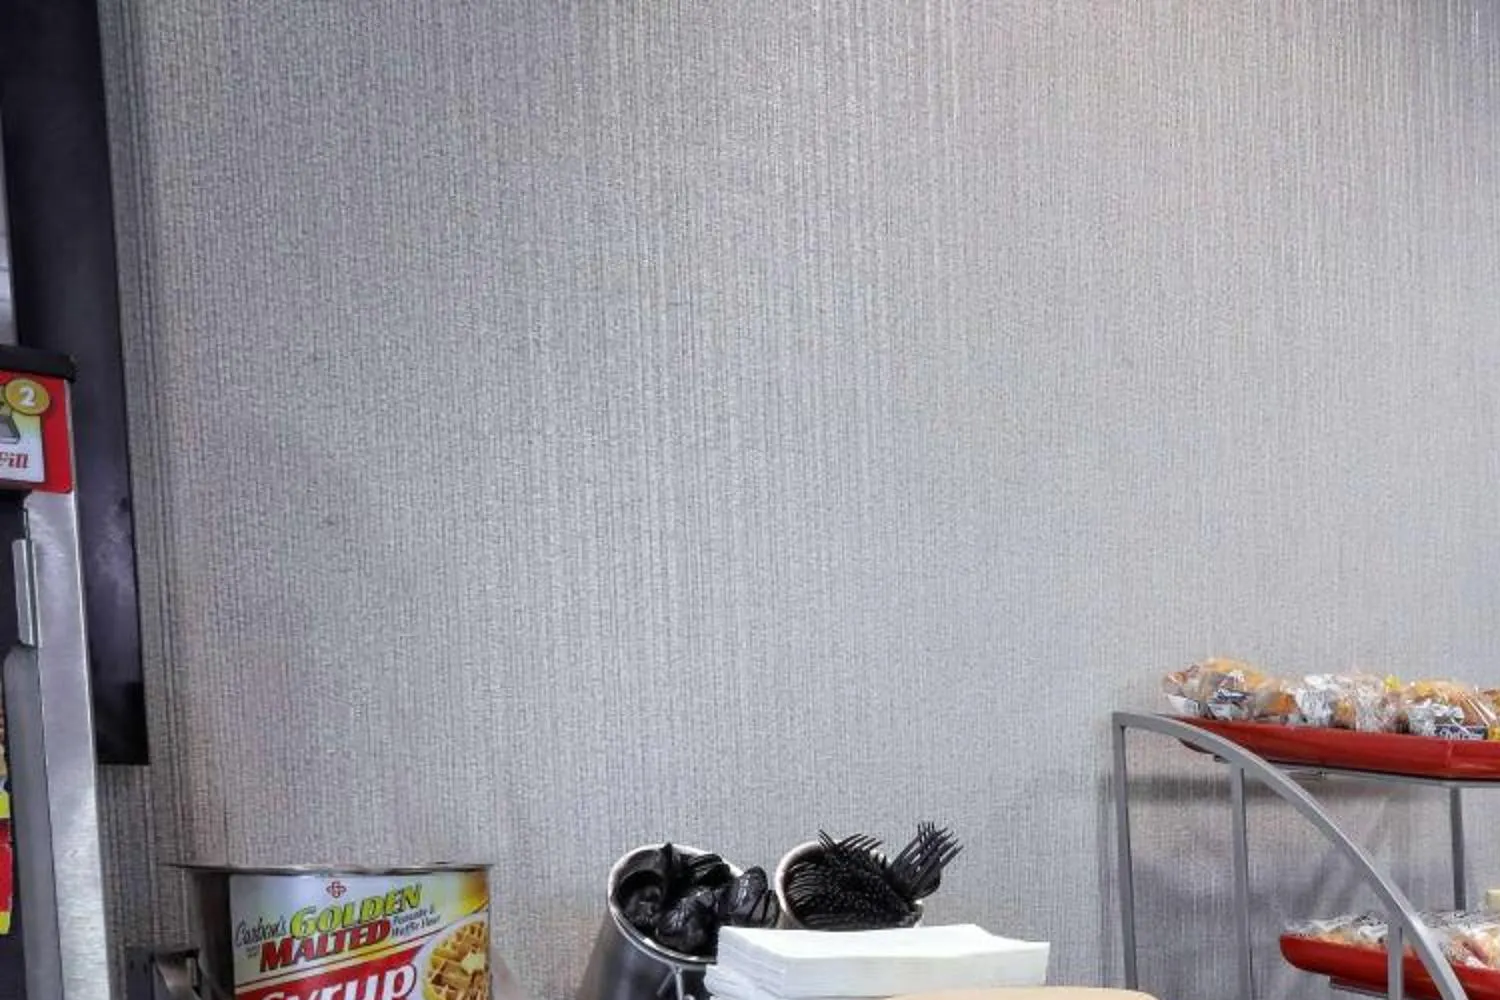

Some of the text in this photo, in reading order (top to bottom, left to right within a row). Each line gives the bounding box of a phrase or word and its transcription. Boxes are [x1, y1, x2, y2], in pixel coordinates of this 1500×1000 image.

[19, 386, 36, 407] 2
[289, 883, 422, 939] GOLDEN
[259, 918, 392, 973] MALTED
